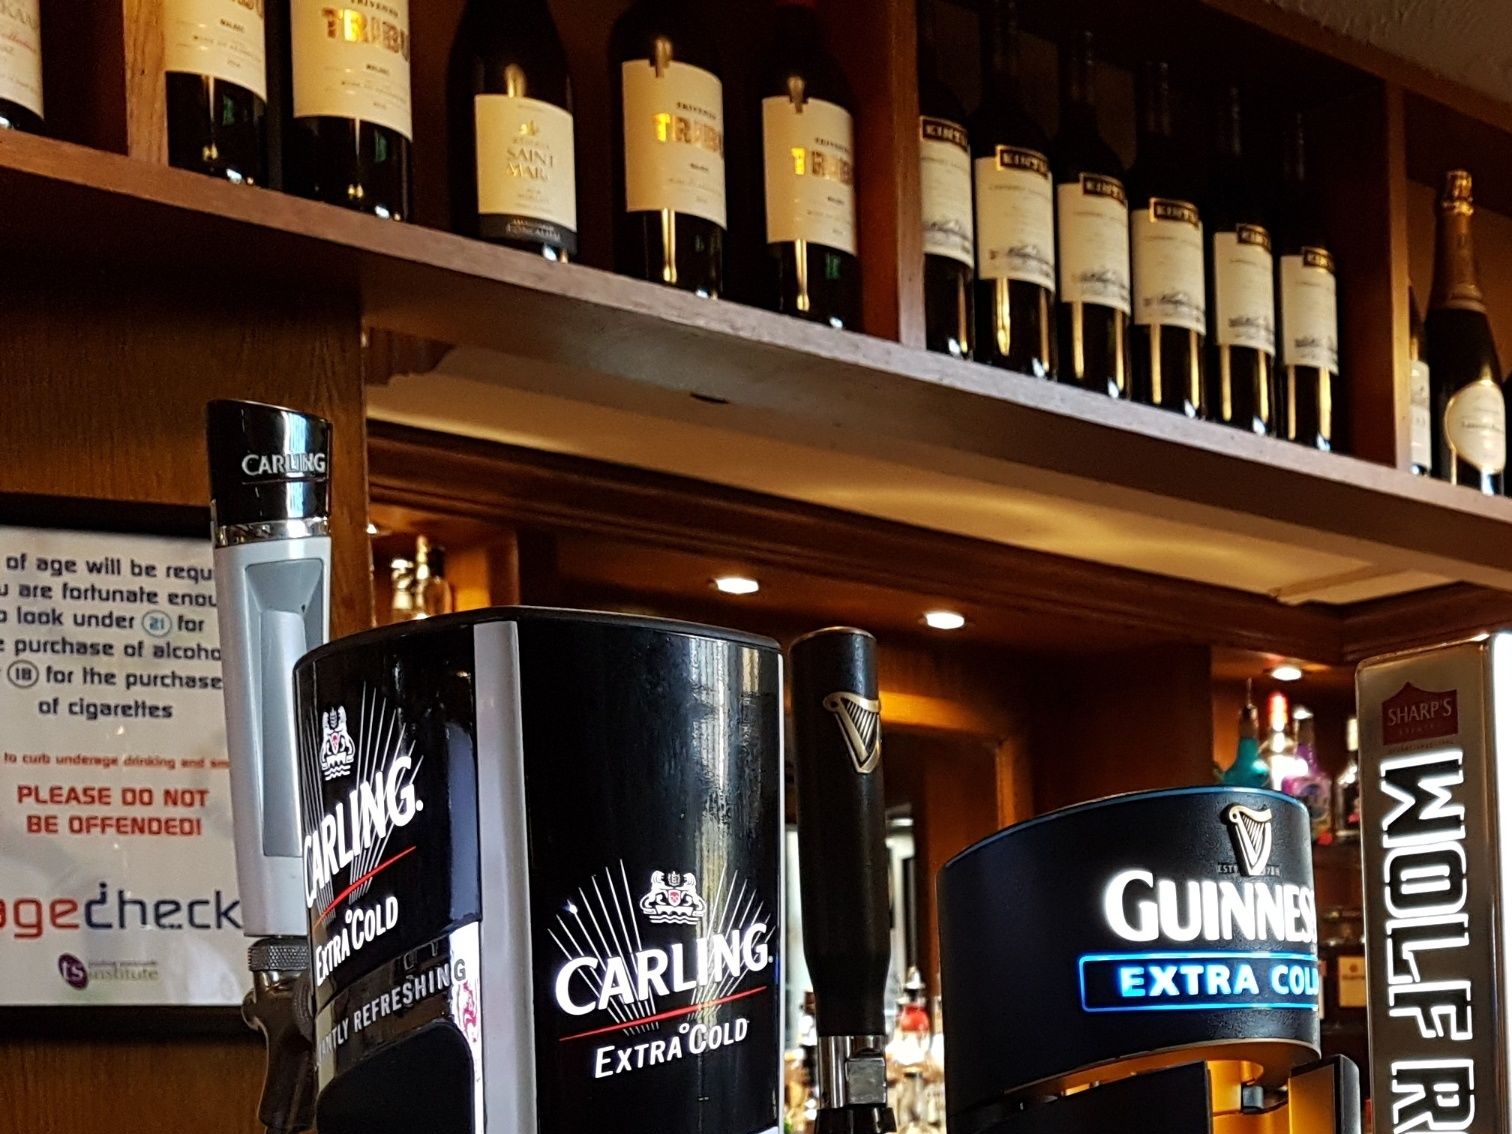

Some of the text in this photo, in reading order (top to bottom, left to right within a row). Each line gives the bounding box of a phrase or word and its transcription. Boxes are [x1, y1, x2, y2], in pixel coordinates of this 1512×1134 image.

[505, 146, 554, 169] SAINT
[241, 453, 326, 476] CARLING
[6, 553, 27, 571] of
[36, 557, 77, 577] age
[86, 557, 122, 576] will
[131, 560, 157, 578] be
[19, 583, 53, 600] are
[62, 582, 160, 605] fortunate
[17, 606, 63, 626] look
[73, 610, 135, 630] under
[177, 615, 205, 633] for
[15, 637, 115, 657] purchase
[124, 641, 145, 658] of
[15, 667, 223, 690] 18 for the purchase
[38, 697, 174, 720] of cigarettes
[1387, 698, 1452, 727] SHARP'S
[22, 753, 50, 765] curb
[55, 753, 118, 768] underage
[123, 755, 176, 770] drinking
[181, 757, 205, 769] and
[17, 785, 211, 808] PLEASE DO NOT
[26, 815, 204, 837] BE OFFENDED!
[304, 756, 417, 909] CARLING
[1380, 750, 1473, 1041] WOLF
[315, 928, 351, 987] EXTRA
[555, 922, 769, 1018] CARLING
[1118, 964, 1260, 998] EXTRA
[353, 958, 467, 1033] REFRESHING
[593, 1035, 682, 1079] EXTRA
